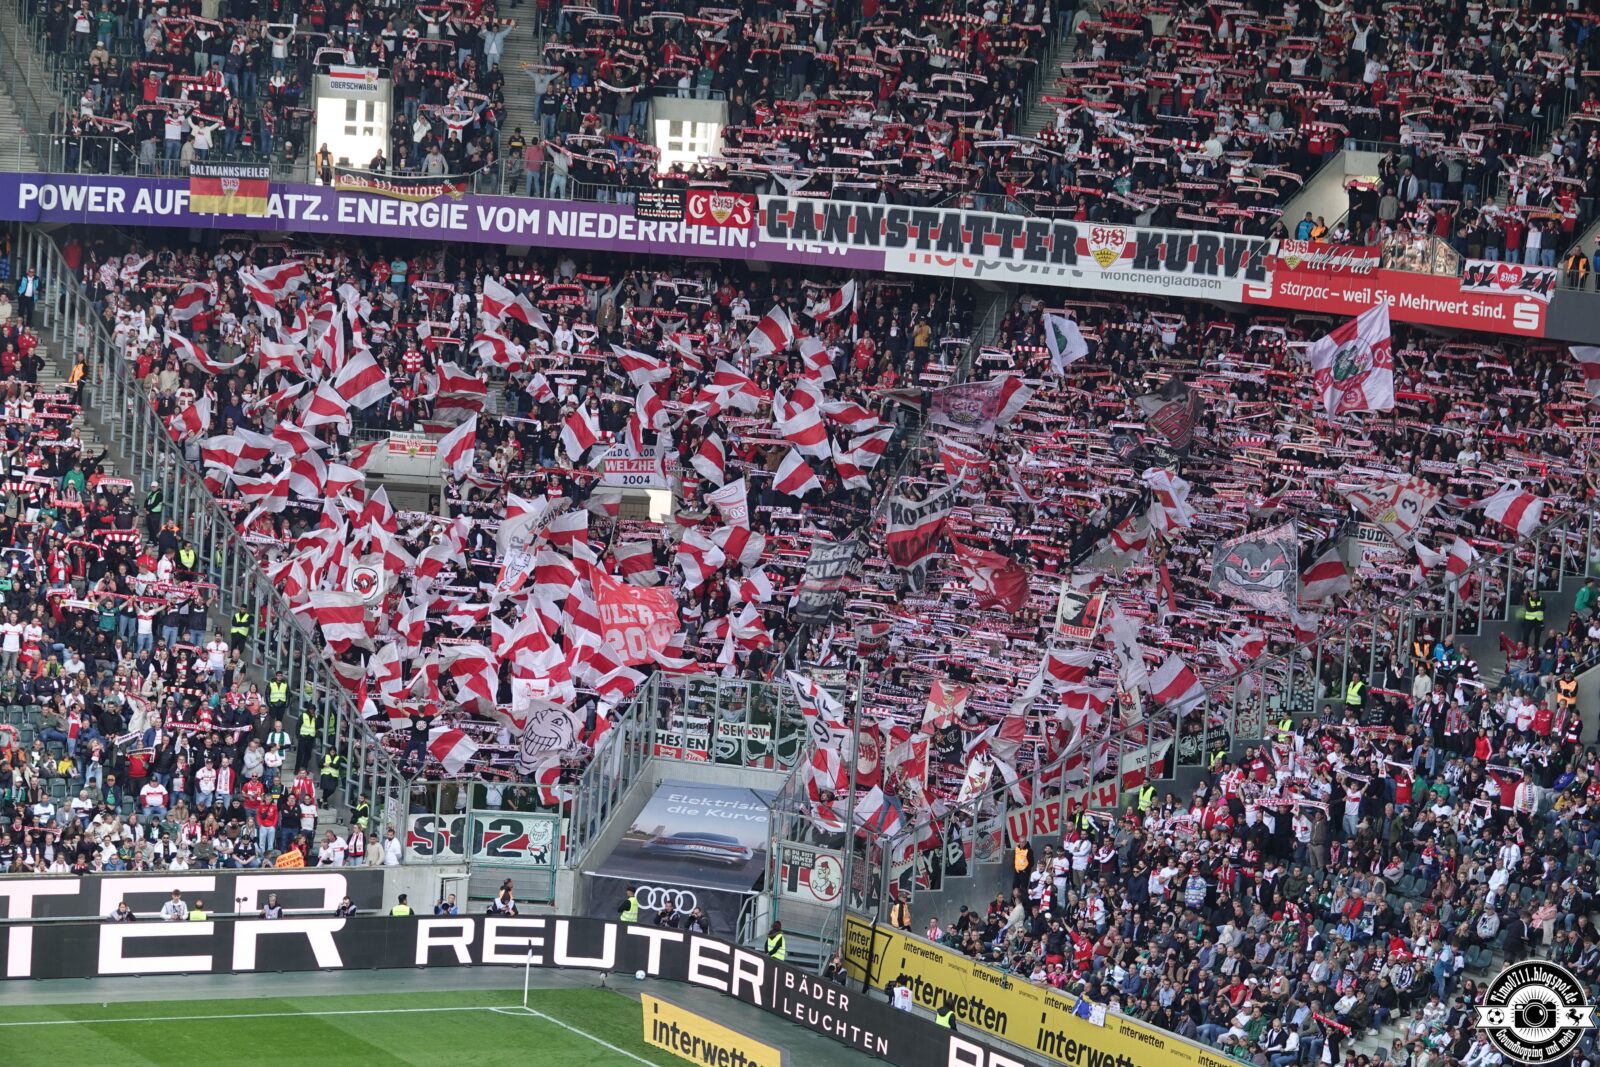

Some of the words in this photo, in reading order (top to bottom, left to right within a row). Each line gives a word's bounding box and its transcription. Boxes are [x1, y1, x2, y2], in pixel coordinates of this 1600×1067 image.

[330, 81, 378, 91] OBERSCHWABEN
[190, 164, 270, 178] BALTMANNSWEILER
[374, 179, 443, 197] Warriors
[639, 192, 680, 203] NECKAR
[19, 183, 125, 213] POWER
[338, 198, 469, 229] ENERGIE
[476, 206, 540, 234] VOM
[547, 210, 757, 248] NIEDERRHEIN.
[766, 198, 1078, 266] CANNSTATTER
[1132, 231, 1268, 283] KURVE
[1280, 281, 1329, 300] starpac
[1343, 288, 1371, 304] weil
[1374, 291, 1396, 307] Sie
[1399, 293, 1468, 316] Mehrwert
[1472, 302, 1506, 319] sind.
[605, 460, 656, 471] WELZHE
[623, 476, 650, 484] 2004
[600, 603, 656, 625] ULTR
[655, 732, 706, 750] HESEN
[723, 724, 744, 737] SEK
[752, 728, 766, 740] SV
[667, 806, 699, 815] die
[668, 794, 768, 812] Elektrisie
[1009, 783, 1117, 843] URBACH
[848, 921, 870, 946] inter
[415, 918, 765, 1006] REUTER
[903, 937, 943, 964] interwetten
[785, 972, 850, 1012] BÄDER
[1044, 991, 1074, 1014] interwe
[653, 1002, 764, 1067] interwett
[783, 996, 889, 1056] LEUCHTEN
[1119, 1020, 1165, 1050] interwetten
